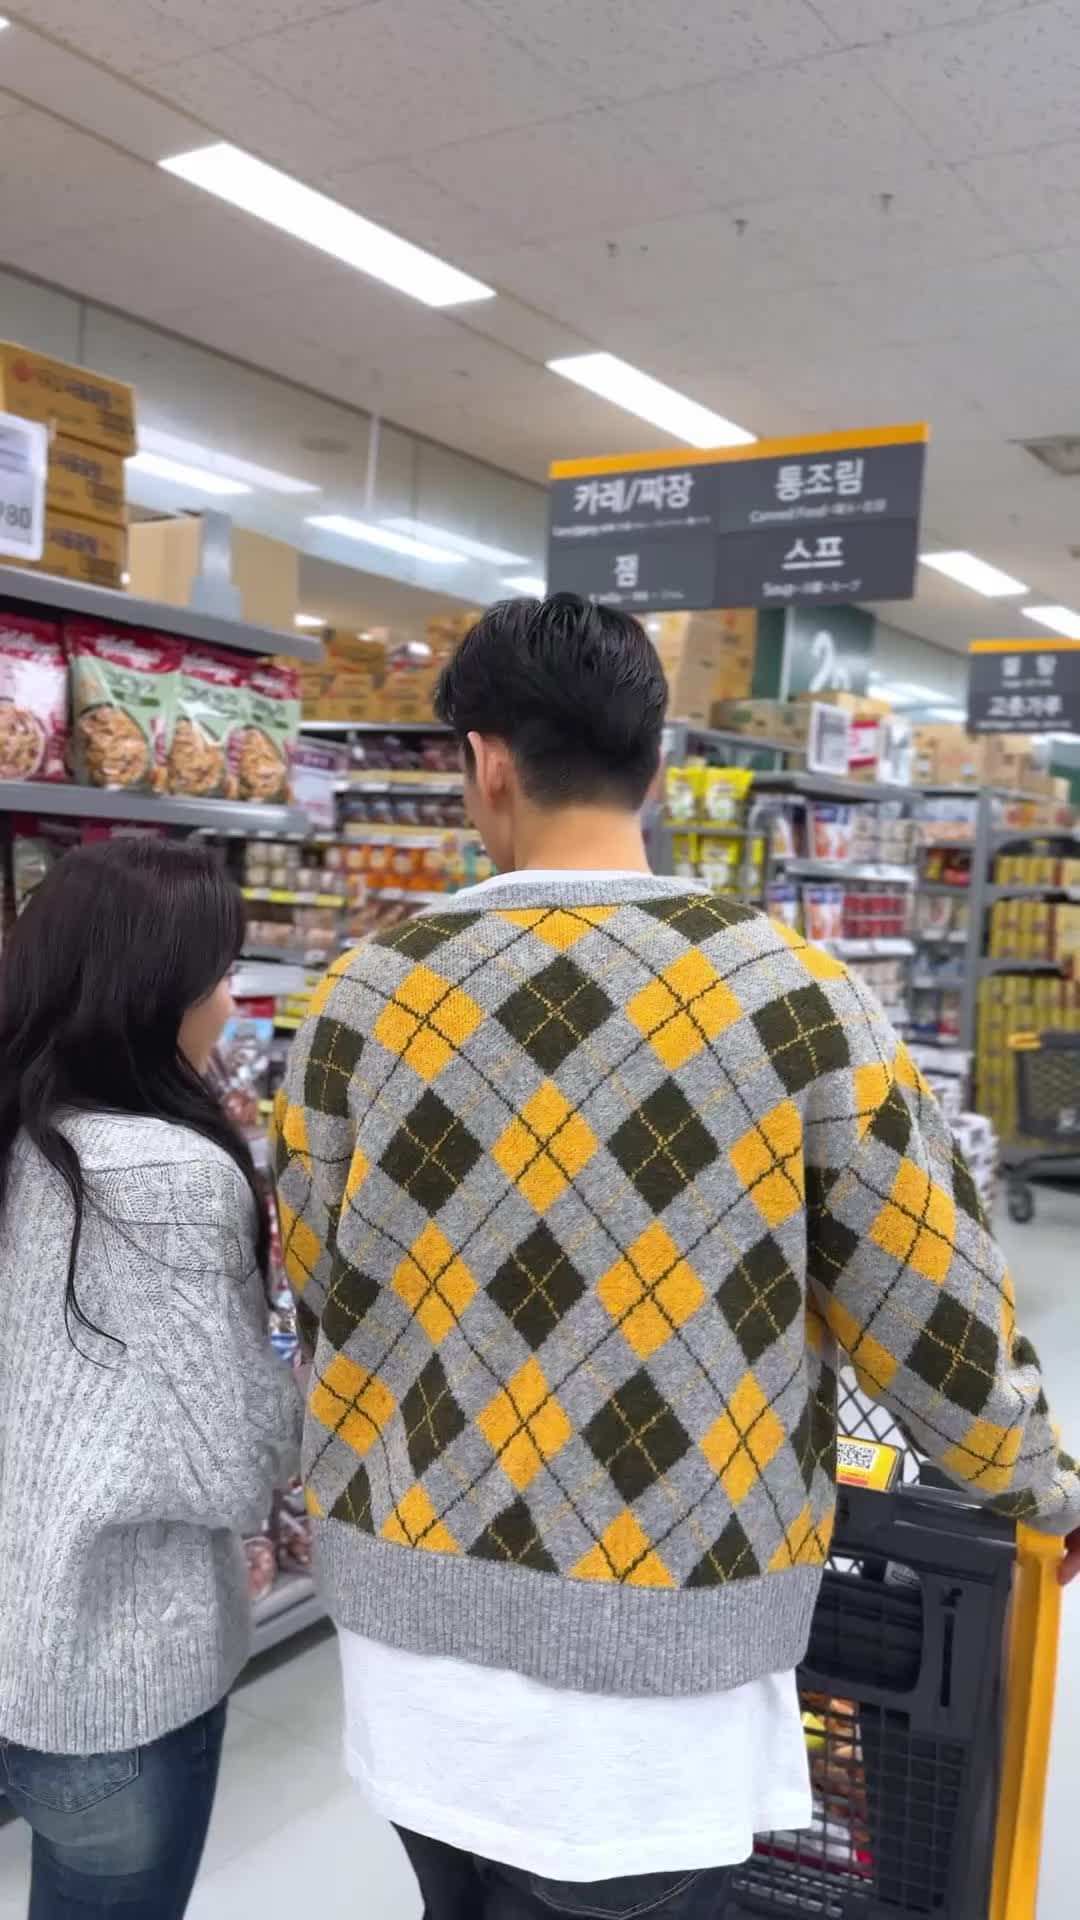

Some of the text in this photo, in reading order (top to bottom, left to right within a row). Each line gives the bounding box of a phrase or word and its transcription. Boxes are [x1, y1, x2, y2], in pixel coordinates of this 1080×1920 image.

[573, 472, 694, 515] 카레/짜장
[775, 457, 864, 502] 통조림
[781, 536, 845, 570] 스프
